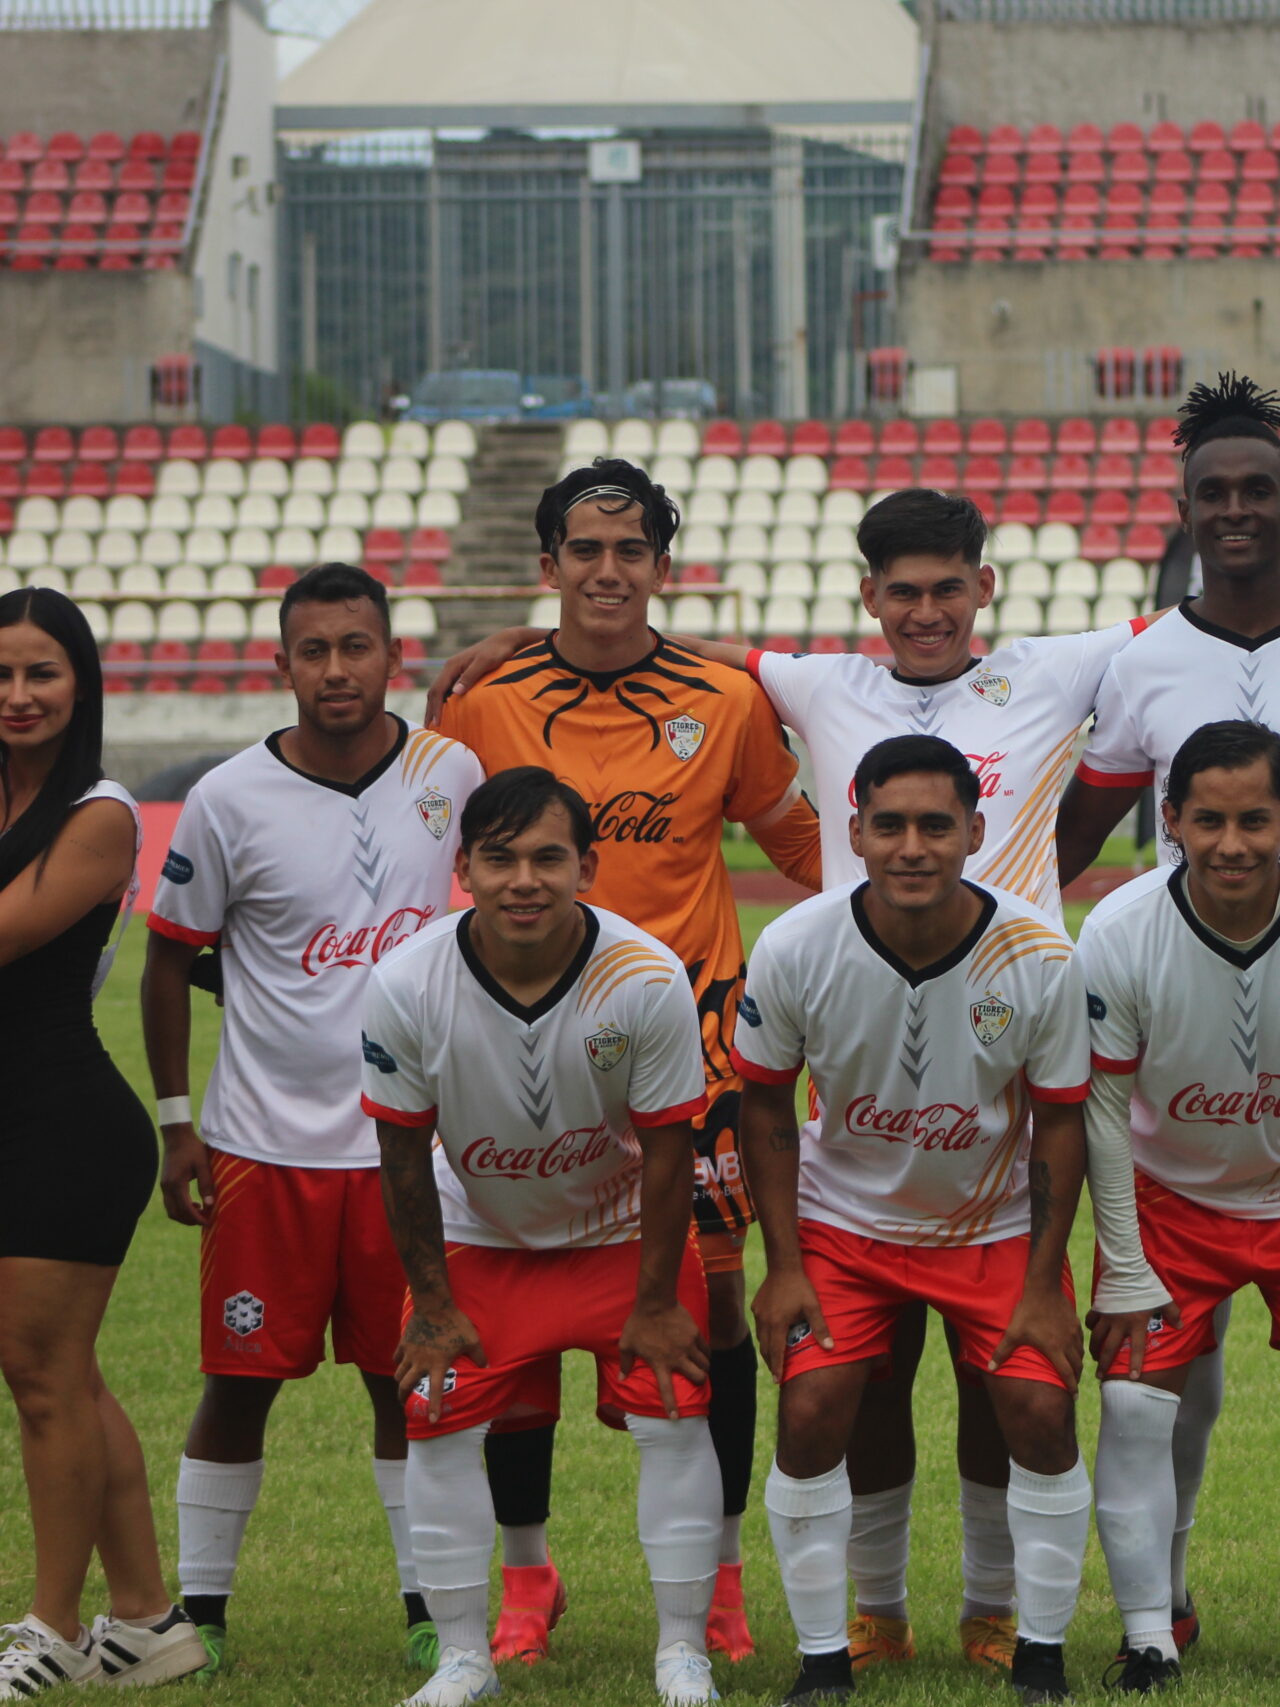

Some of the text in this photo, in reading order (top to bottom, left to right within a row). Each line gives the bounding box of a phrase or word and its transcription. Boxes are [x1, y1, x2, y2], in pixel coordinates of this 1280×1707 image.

[671, 721, 699, 730] TIGRES
[1003, 789, 1015, 797] MR
[977, 1005, 1007, 1014] TIGRES
[592, 1036, 622, 1045] TIGRES
[845, 1095, 980, 1152] Coca-Cola
[461, 1119, 609, 1181] Coca-Cola
